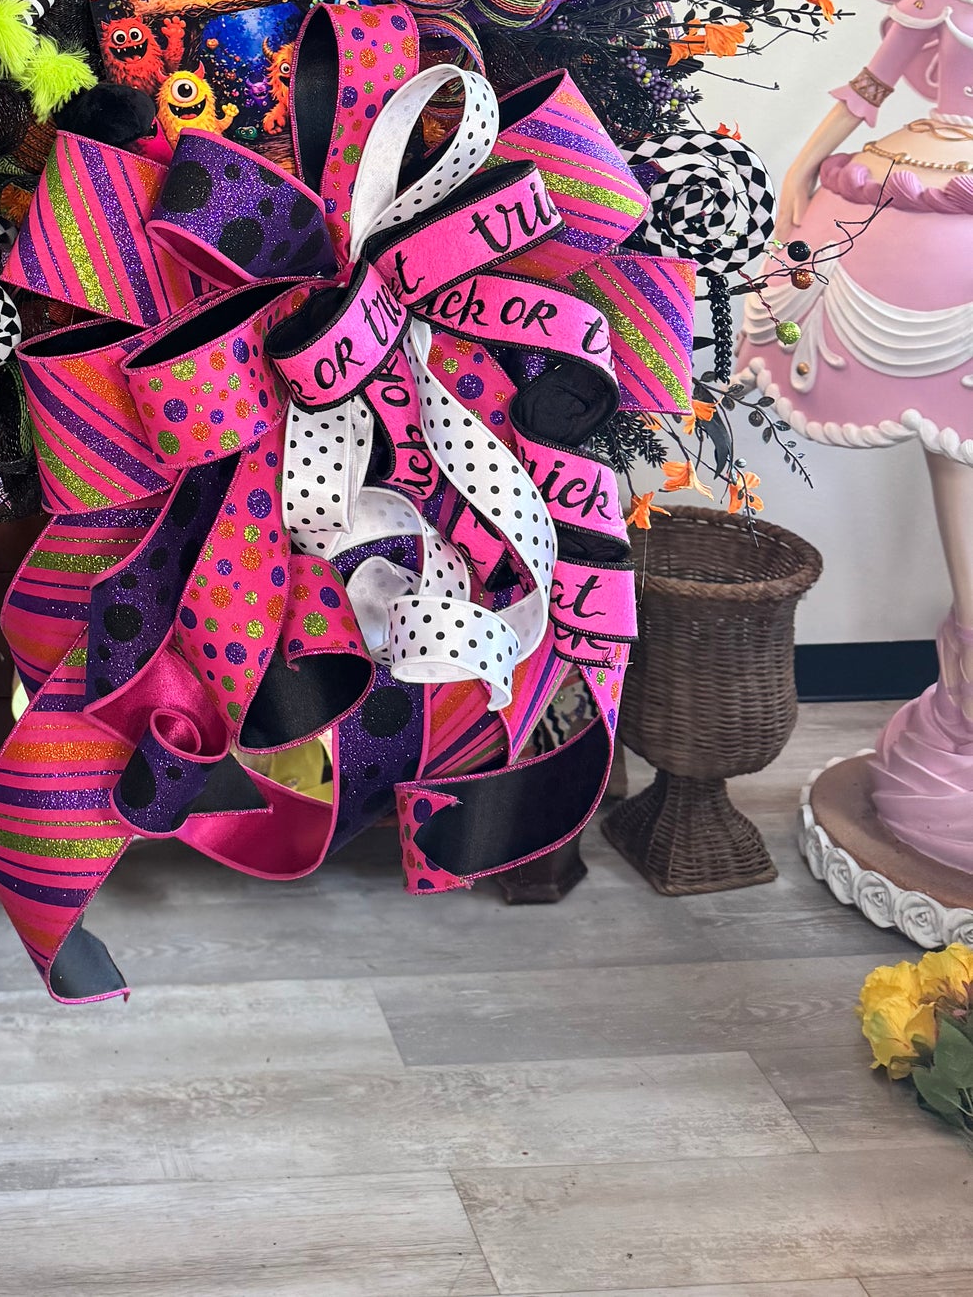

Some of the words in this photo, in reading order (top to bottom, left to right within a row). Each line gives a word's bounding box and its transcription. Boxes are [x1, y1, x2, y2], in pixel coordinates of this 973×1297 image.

[468, 182, 557, 253] tri
[499, 296, 558, 337] OR
[314, 336, 366, 390] OR
